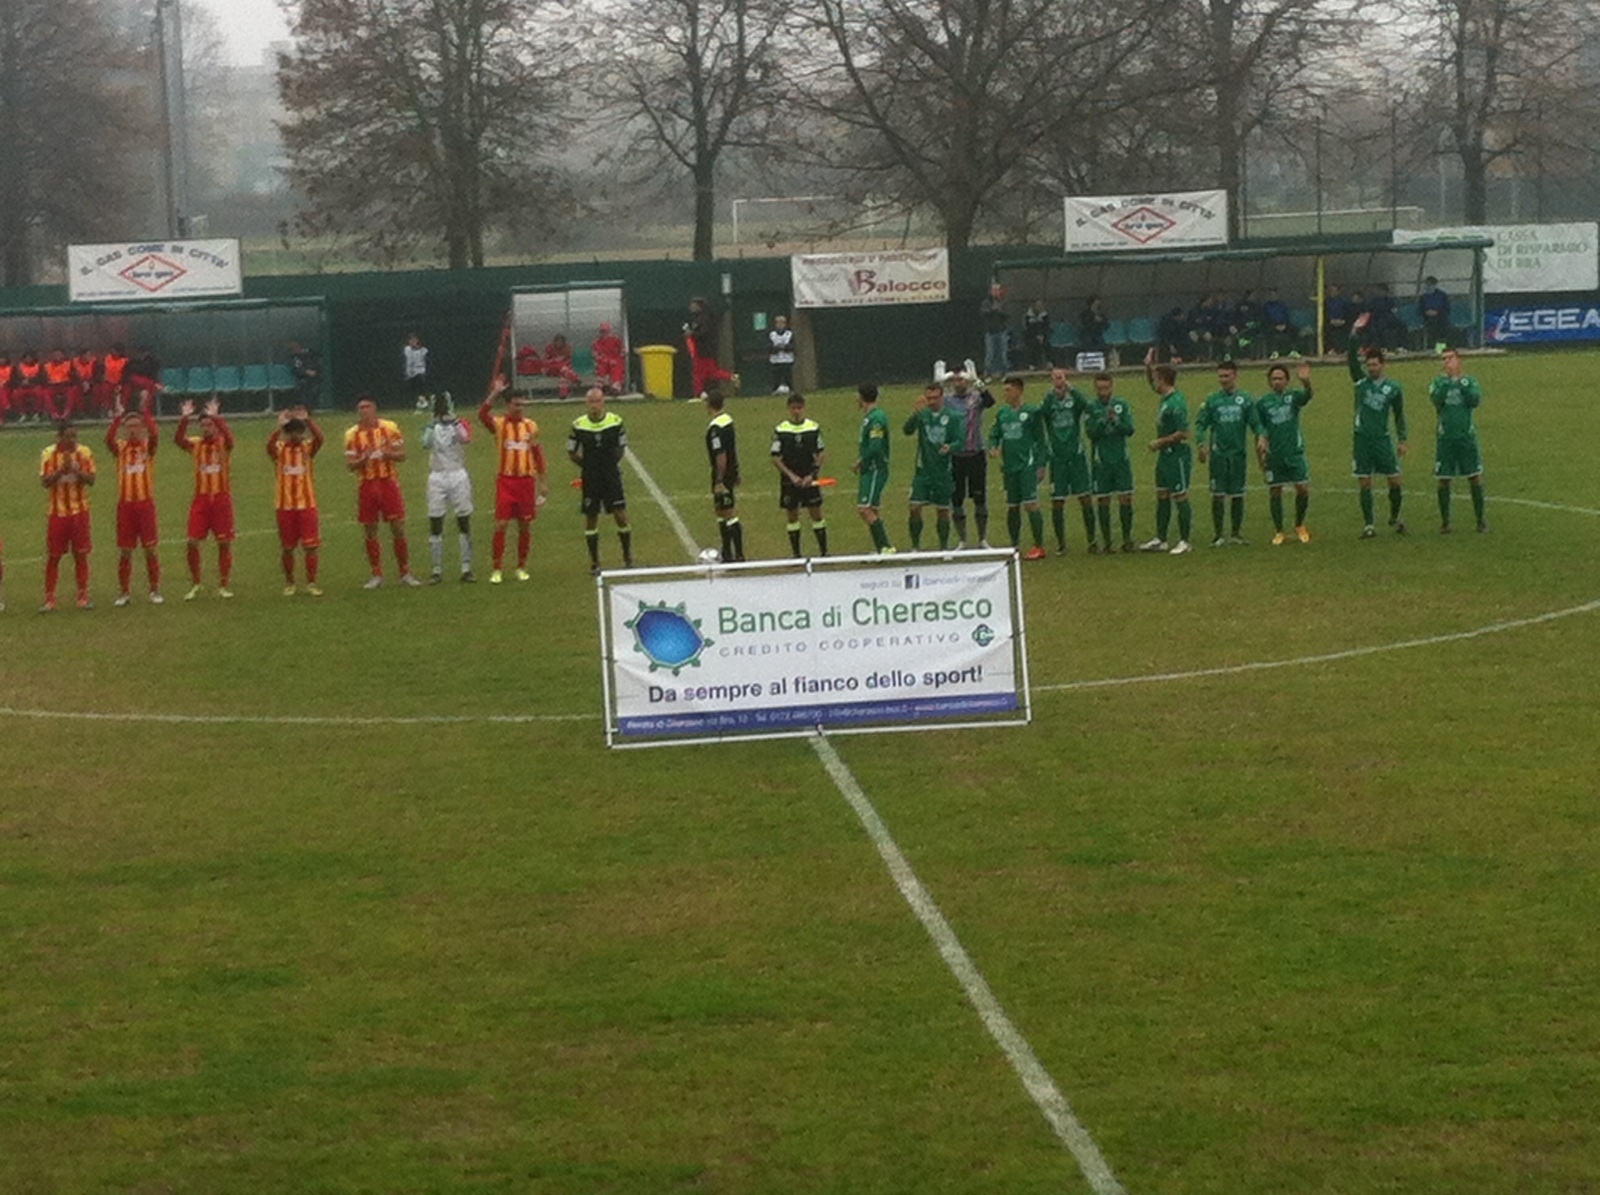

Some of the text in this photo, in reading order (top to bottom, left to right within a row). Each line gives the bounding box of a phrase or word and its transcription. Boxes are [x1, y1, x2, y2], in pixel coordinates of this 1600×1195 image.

[1090, 204, 1116, 219] GAS
[1121, 197, 1155, 207] COME
[96, 250, 122, 266] GAS
[128, 244, 164, 255] COME
[1497, 242, 1588, 255] DI RISPARMIO
[1497, 257, 1541, 269] DI BRA
[853, 269, 946, 295] Balocco
[1509, 308, 1600, 331] EGEA
[718, 596, 993, 635] Banca di Cherasco
[719, 632, 960, 658] CREDITO COOPERATIVO
[649, 665, 983, 704] Da sempre al fianco dello sport!
